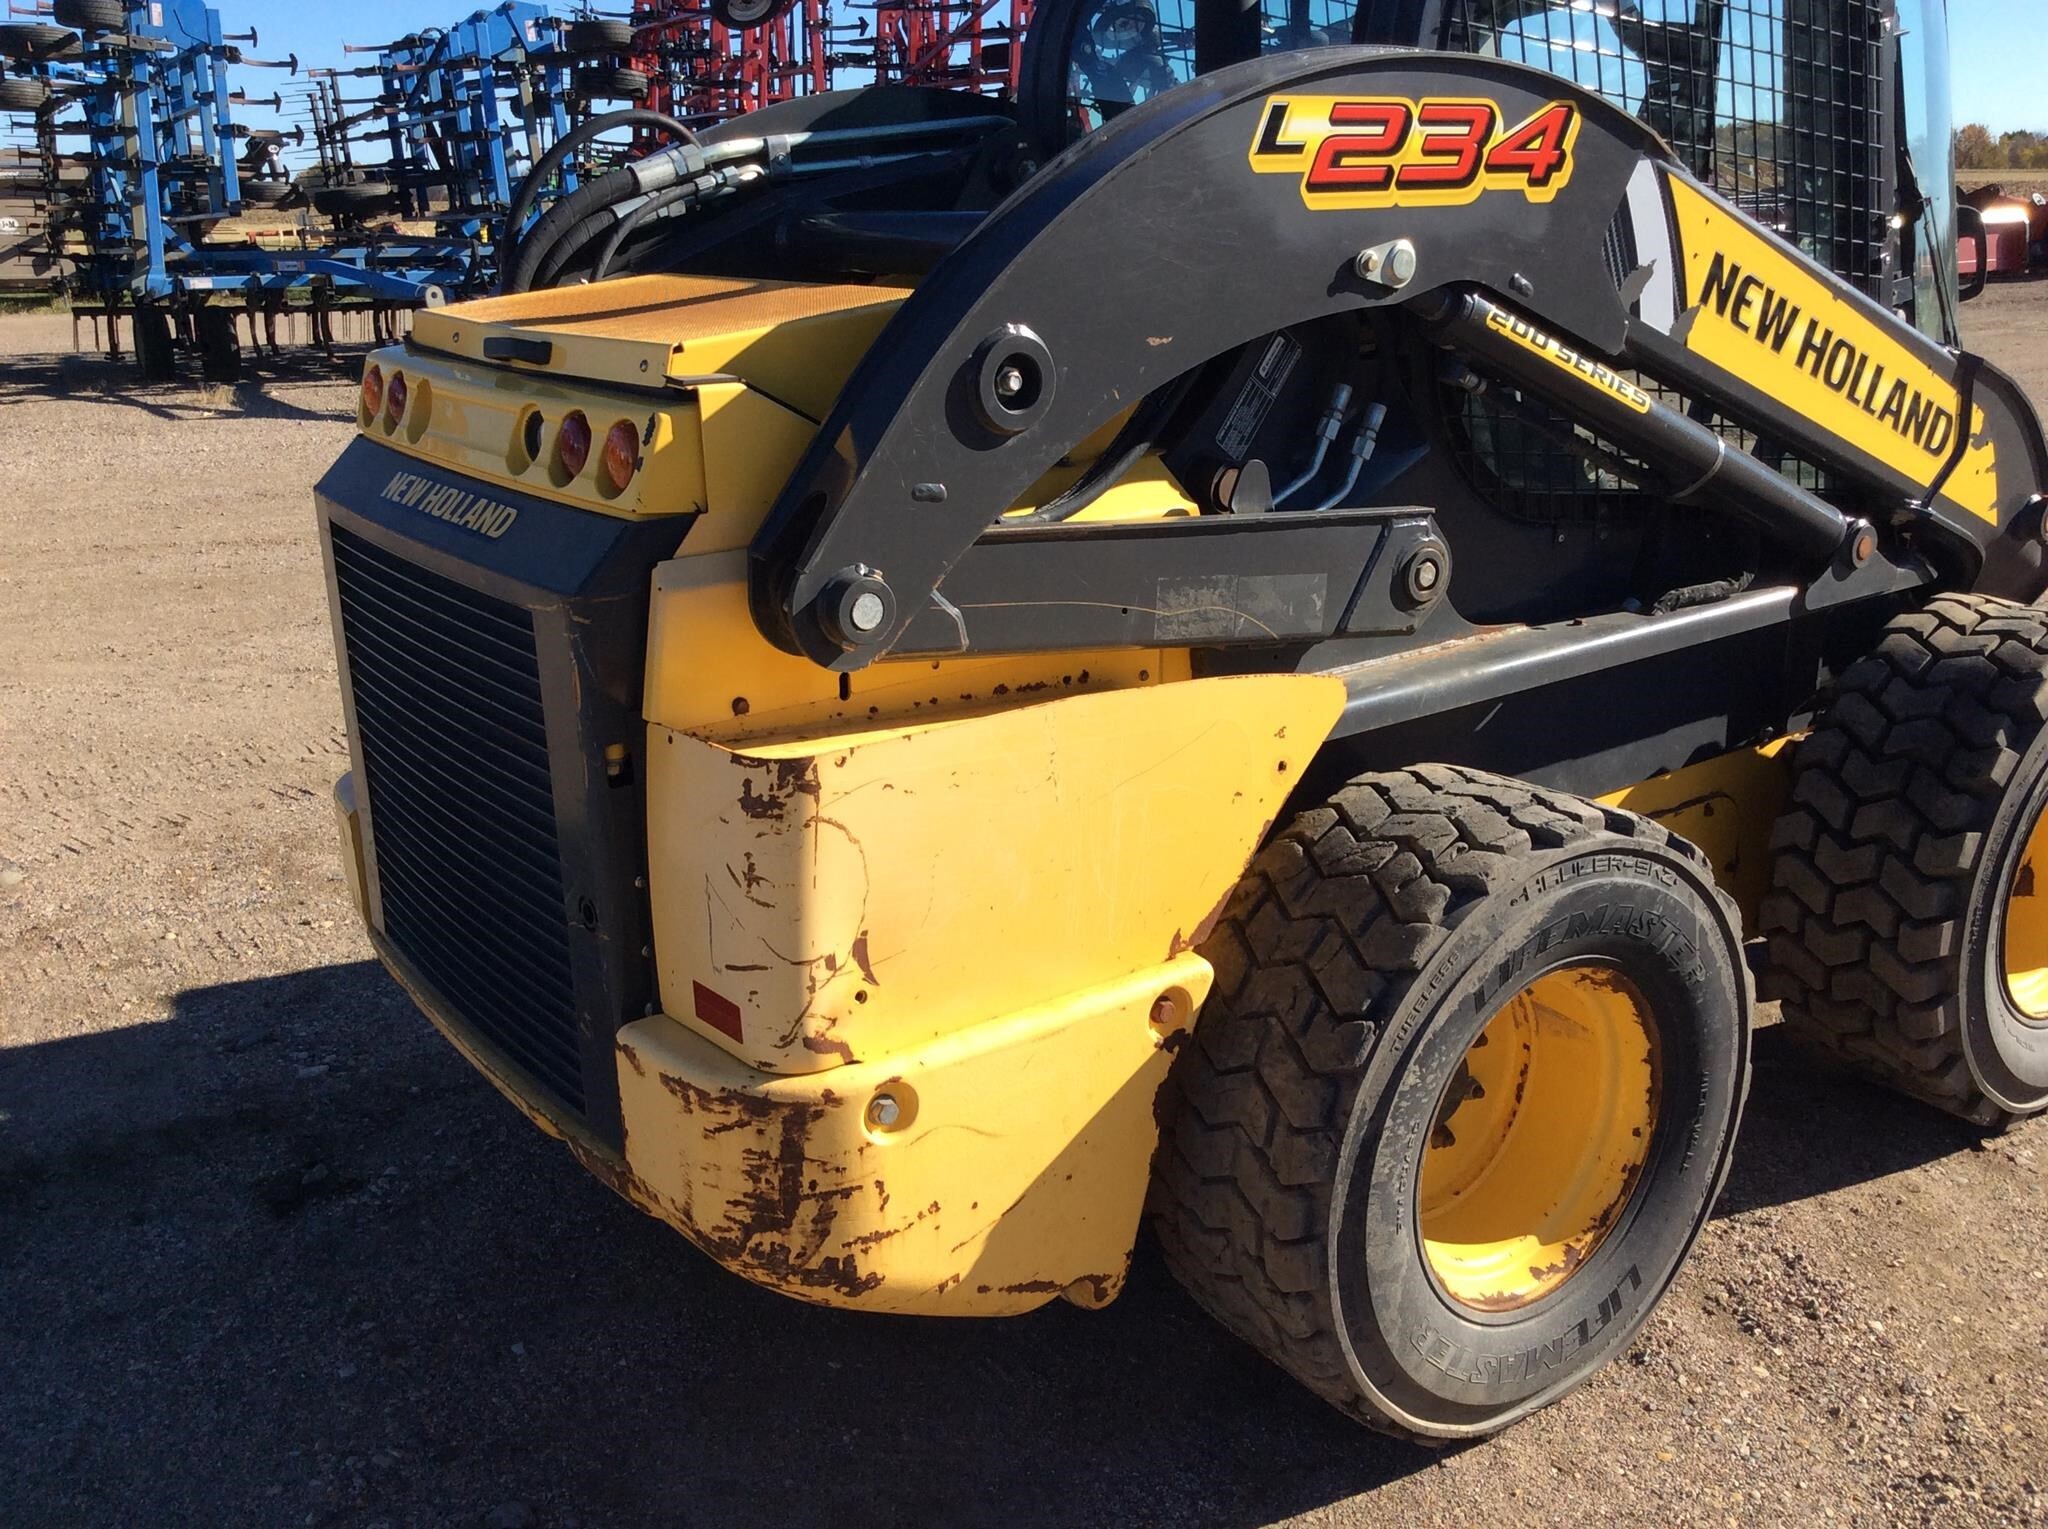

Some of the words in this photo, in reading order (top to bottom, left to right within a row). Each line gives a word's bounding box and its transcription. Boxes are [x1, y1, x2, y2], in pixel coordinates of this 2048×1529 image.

[1253, 100, 1575, 193] L234
[1490, 308, 1550, 350] 200
[1553, 342, 1648, 408] SERIES
[1700, 250, 1800, 356] NEW
[1794, 317, 1954, 458] HOLLAND
[380, 471, 433, 507] NEW
[418, 483, 518, 539] HOLLAND
[1472, 903, 1707, 1005] LIFEMASTER
[1409, 1263, 1643, 1386] LIFEMASTER
